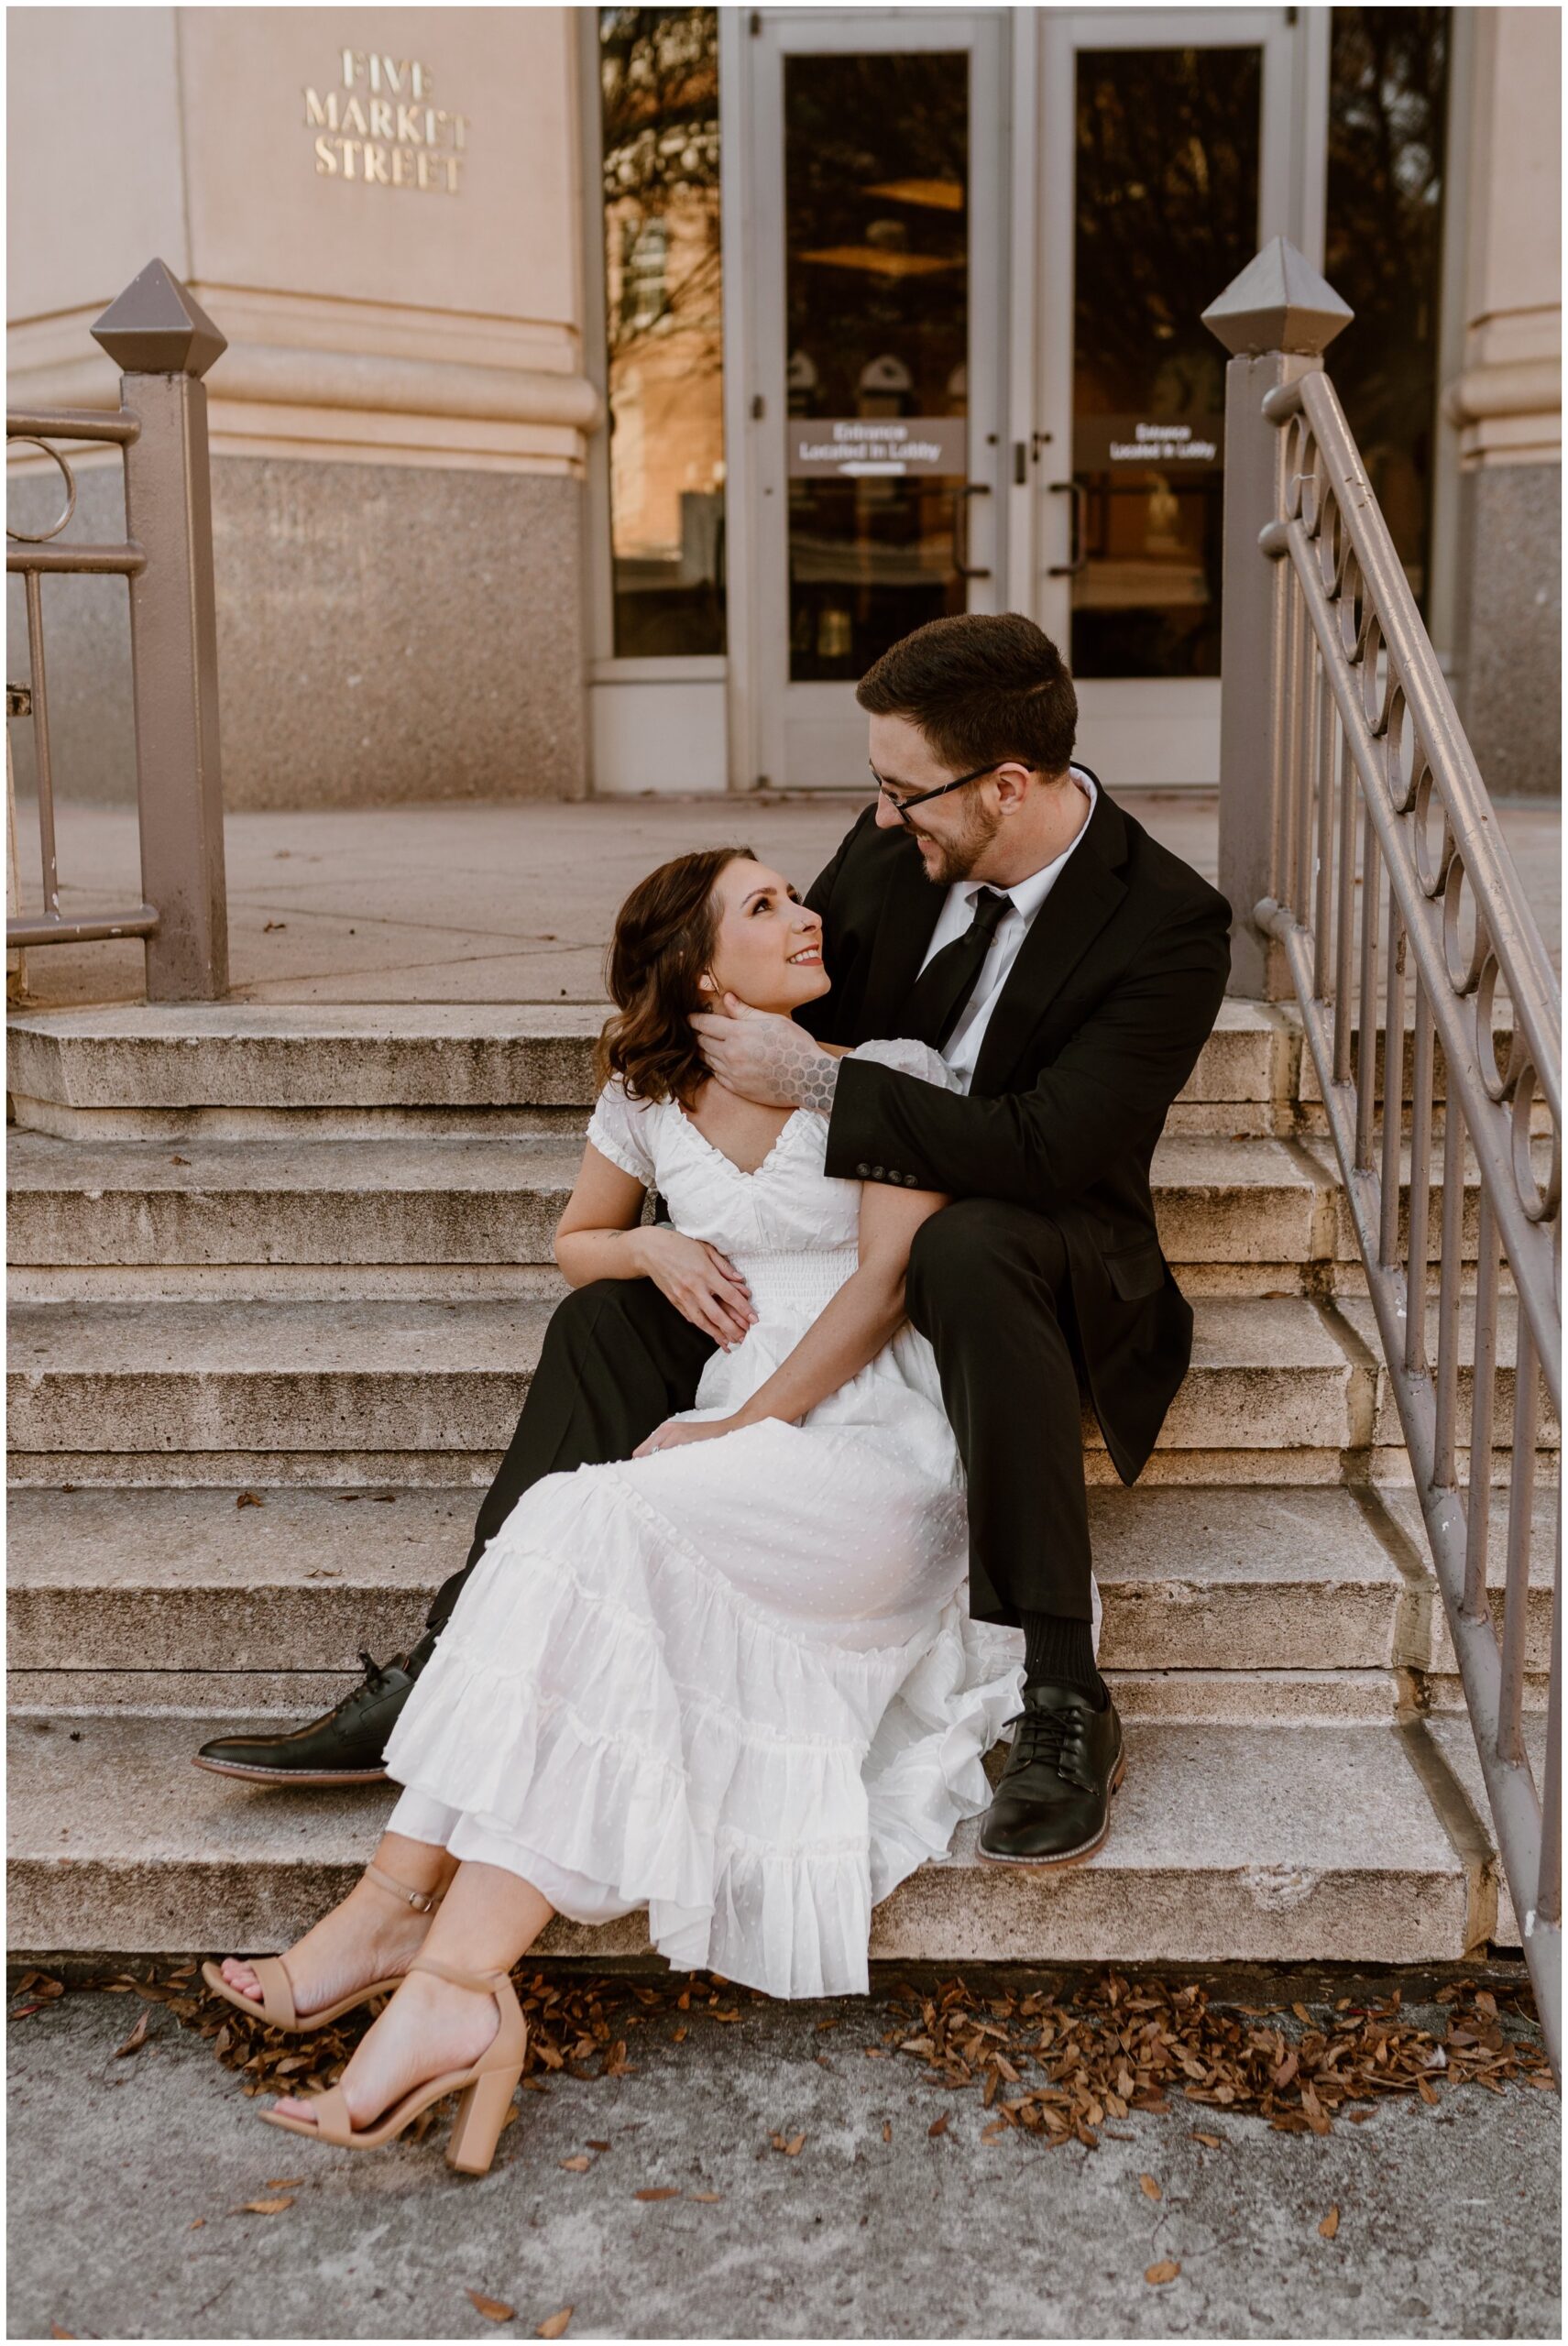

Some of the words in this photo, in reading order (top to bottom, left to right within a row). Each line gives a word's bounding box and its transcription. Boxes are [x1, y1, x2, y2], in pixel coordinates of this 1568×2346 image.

[341, 48, 433, 102] FIVE
[303, 87, 470, 149] MARKET
[315, 136, 464, 194] STREET
[799, 442, 866, 460] Located
[889, 442, 941, 462] Lobby
[833, 422, 907, 441] Entrance
